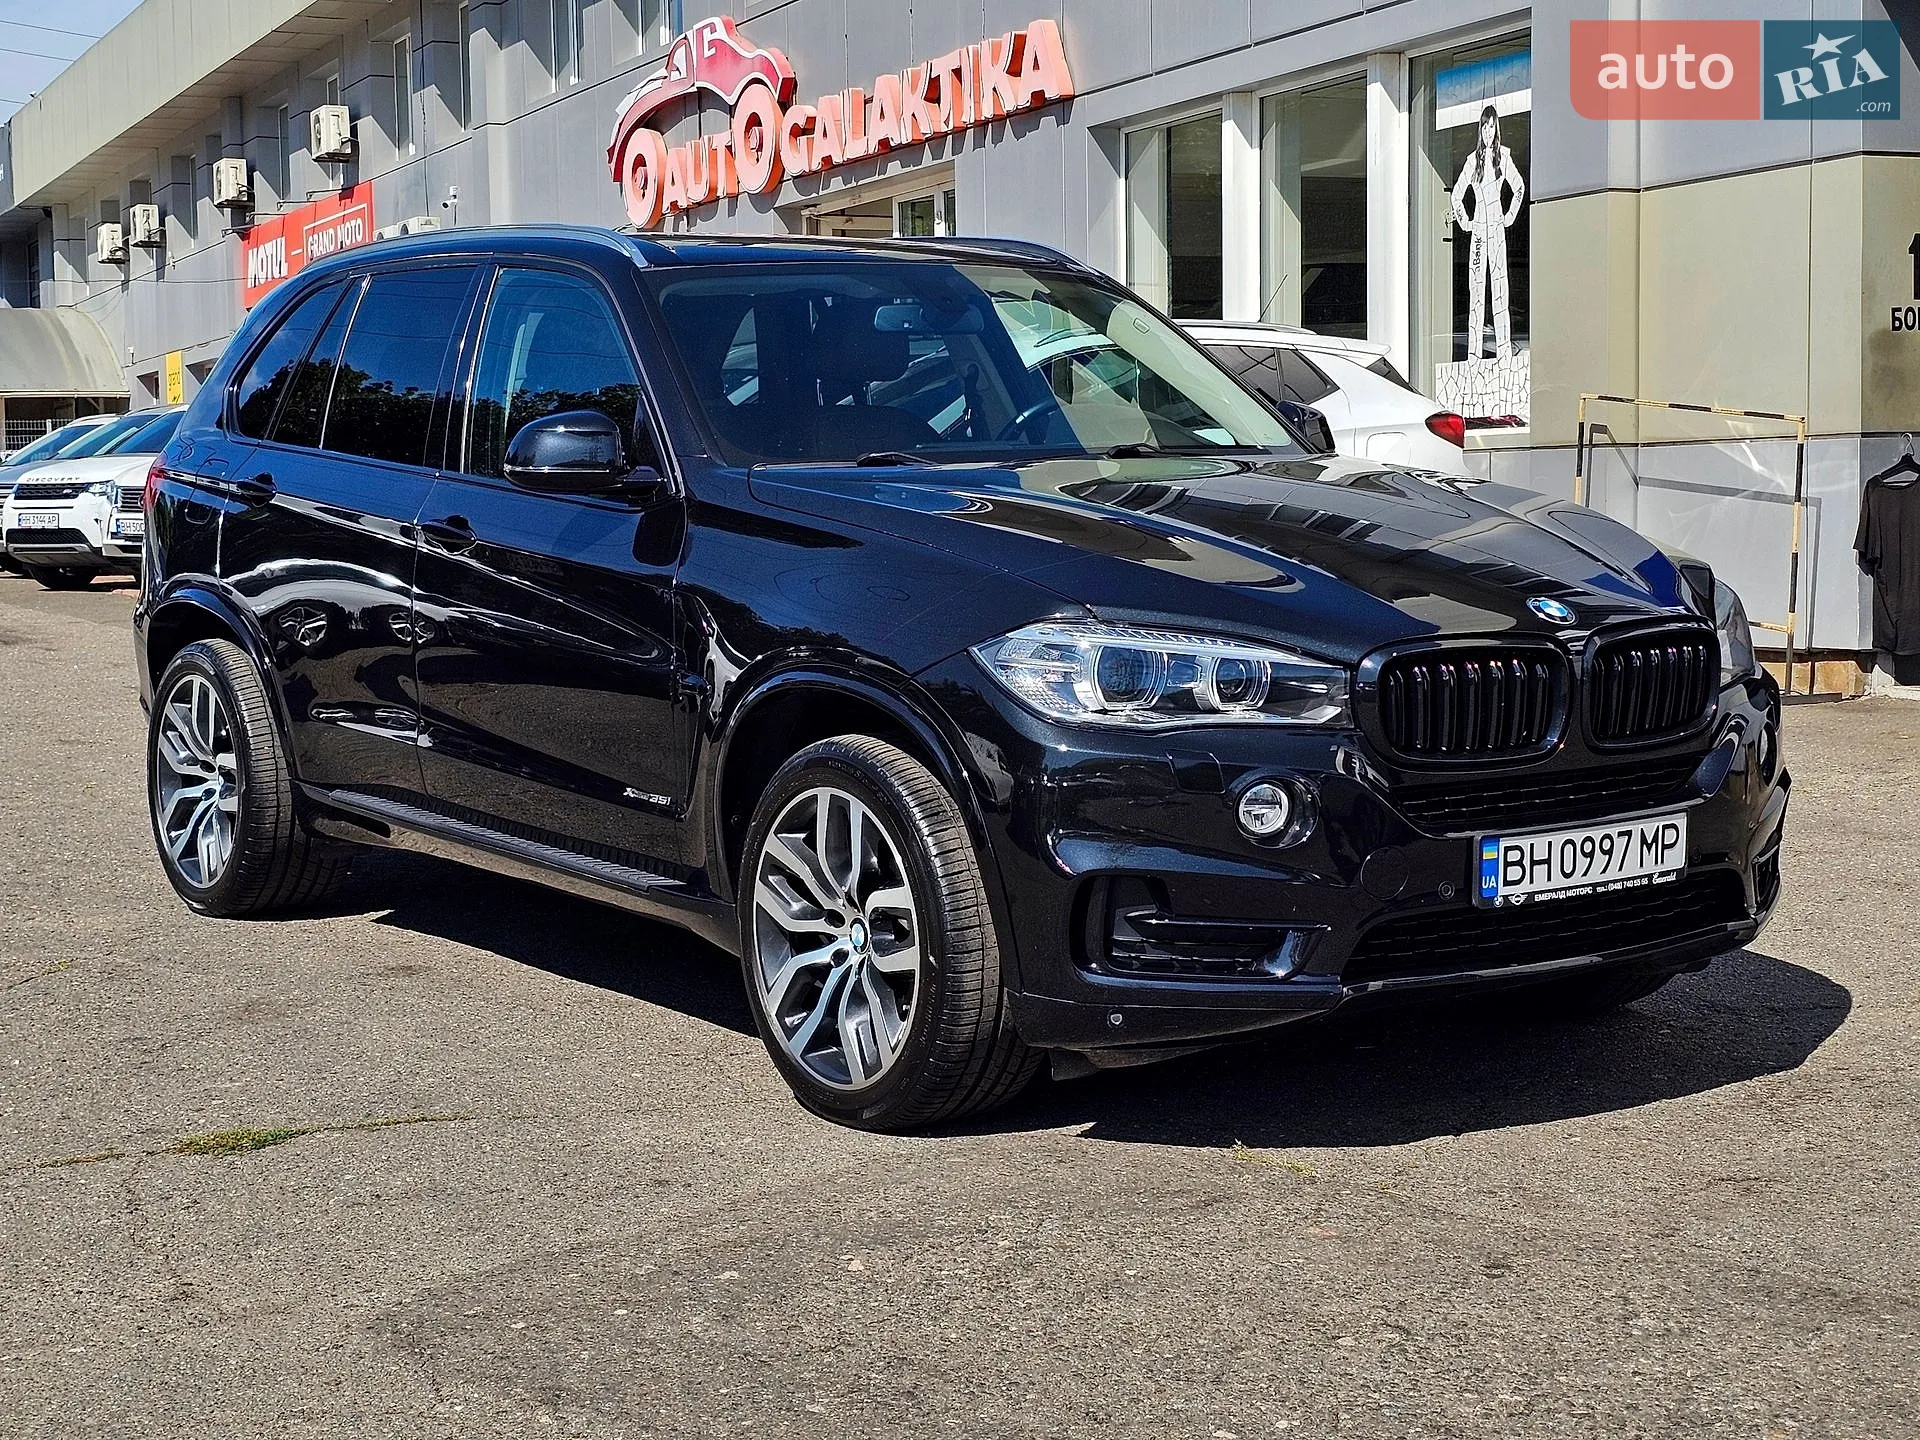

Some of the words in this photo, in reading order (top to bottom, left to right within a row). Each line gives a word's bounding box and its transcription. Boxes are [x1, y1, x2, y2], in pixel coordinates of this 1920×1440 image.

[307, 227, 335, 259] GRAND
[337, 217, 363, 249] MOTO
[247, 236, 289, 289] MOTUL
[1890, 306, 1920, 332] БО
[1502, 840, 1552, 887] BH
[1560, 829, 1633, 880] 0997
[1639, 822, 1680, 869] MP
[1482, 875, 1497, 889] UA
[1534, 890, 1566, 902] ЕМЕРАЛД
[1566, 886, 1593, 897] МОТОРС
